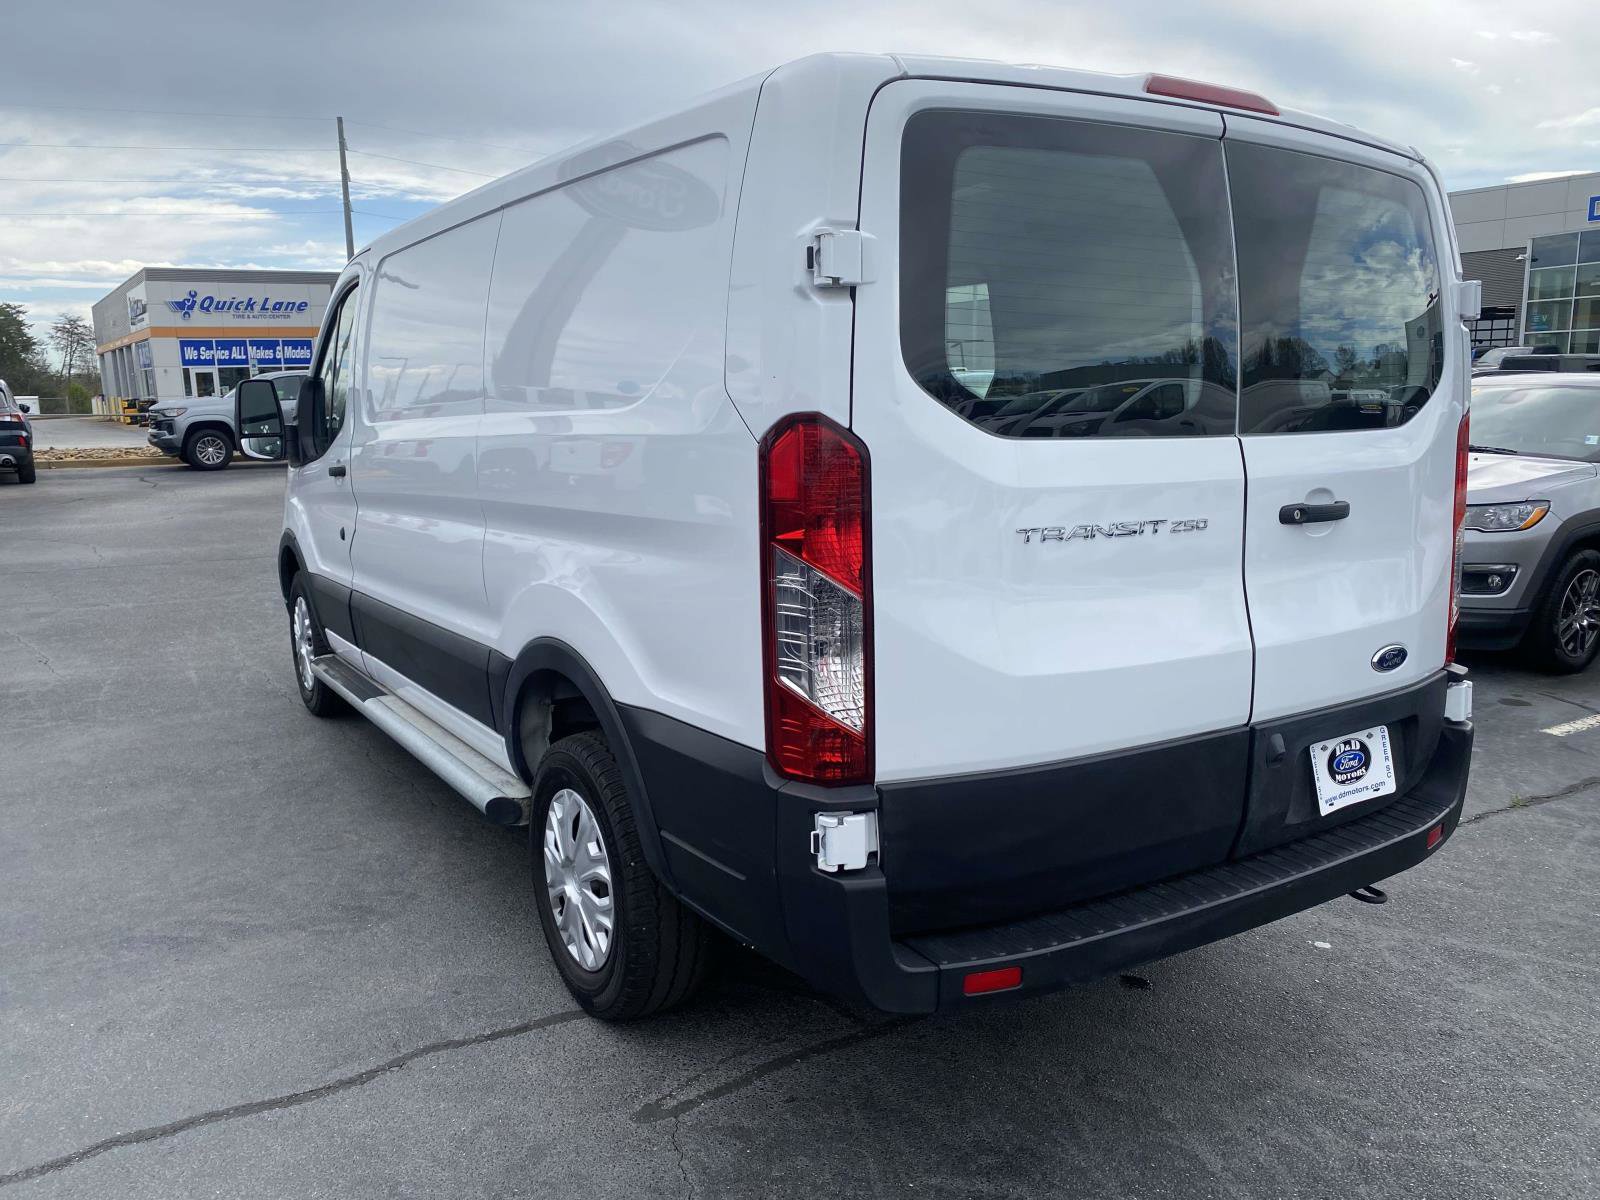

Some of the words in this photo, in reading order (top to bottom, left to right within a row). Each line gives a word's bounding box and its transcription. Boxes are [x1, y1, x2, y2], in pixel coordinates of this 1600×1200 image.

[199, 295, 257, 313] Quick
[259, 297, 309, 312] Lane
[184, 346, 198, 360] We
[200, 346, 231, 360] Service
[231, 346, 246, 360] ALL
[249, 346, 274, 359] Makes
[275, 346, 282, 359] &
[284, 346, 311, 359] Models
[1016, 519, 1168, 544] TRANSIT
[1170, 518, 1209, 534] 250
[1383, 650, 1404, 667] Ford
[1335, 739, 1361, 757] D&D
[1379, 727, 1390, 762] GREER
[1385, 764, 1392, 779] SC
[1339, 754, 1360, 770] Ford
[1335, 766, 1367, 783] MOTORS
[1325, 780, 1386, 805] www.ddmotors.com
